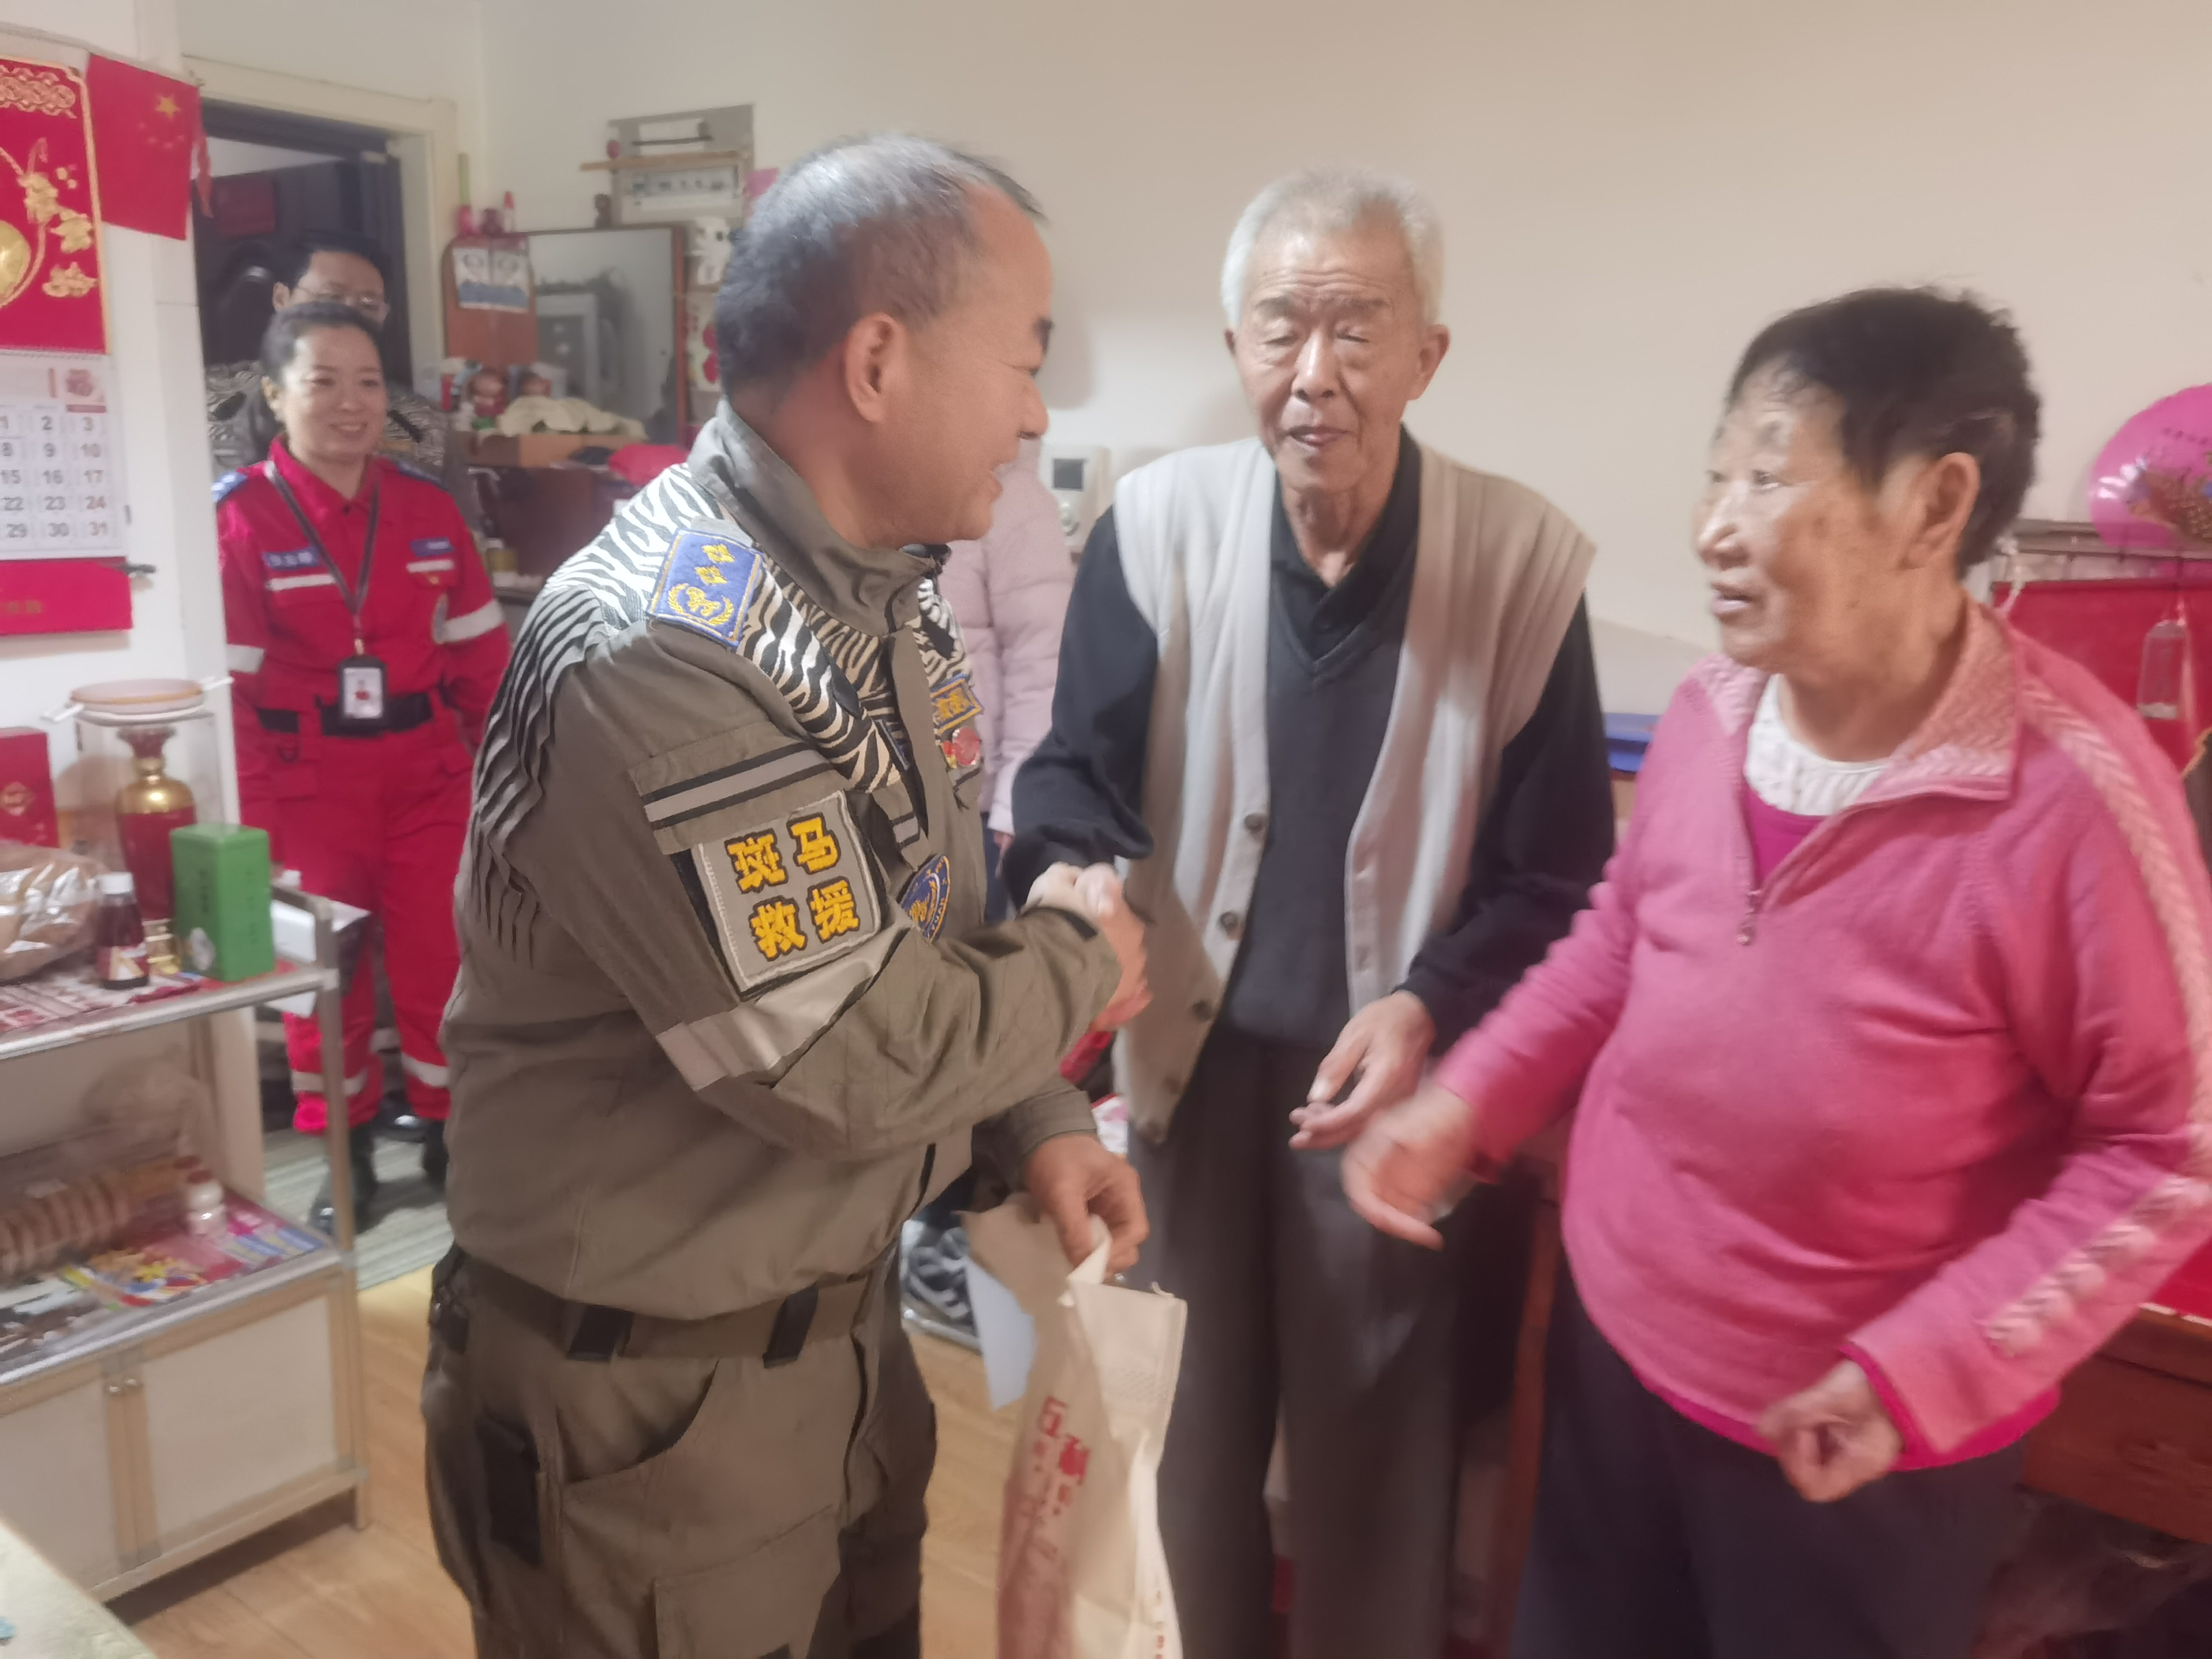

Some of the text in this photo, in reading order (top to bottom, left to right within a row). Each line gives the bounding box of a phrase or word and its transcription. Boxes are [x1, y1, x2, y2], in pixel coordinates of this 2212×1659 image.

[42, 416, 52, 430] 2
[83, 416, 93, 431] 3
[3, 442, 101, 457] 8 9 10
[1, 469, 104, 484] 15 16 17
[2, 496, 106, 511] 22 23 24
[6, 522, 107, 538] 29 30 31
[726, 816, 839, 892] 斑马
[750, 879, 860, 959] 救援
